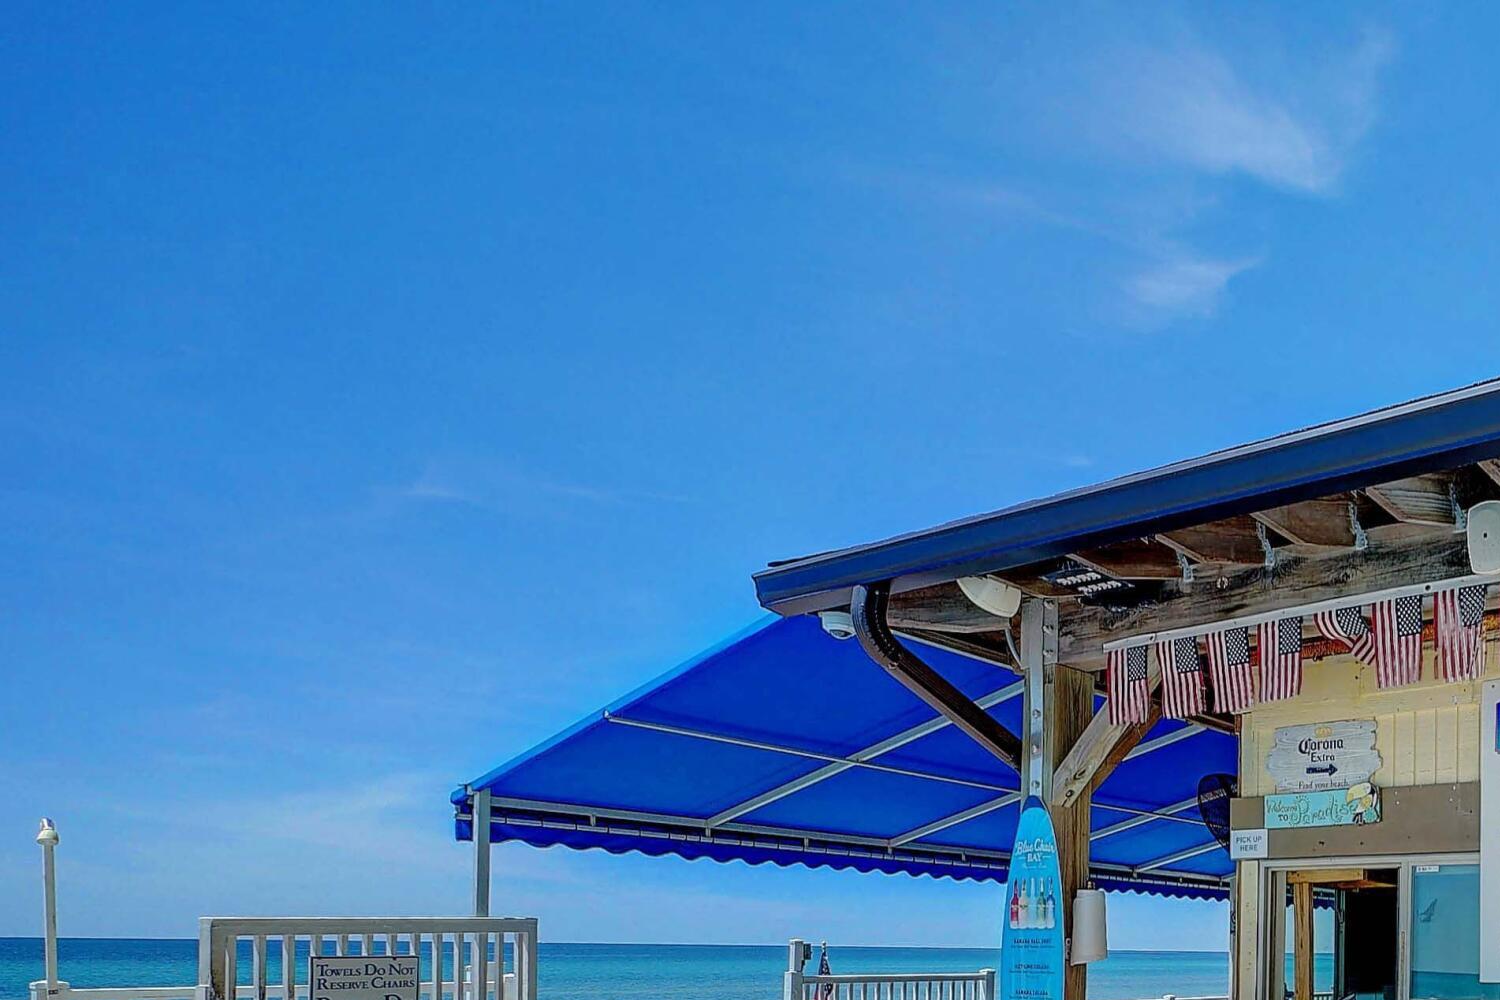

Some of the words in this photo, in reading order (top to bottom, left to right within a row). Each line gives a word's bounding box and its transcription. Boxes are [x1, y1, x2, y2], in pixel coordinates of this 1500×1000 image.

[1298, 738, 1343, 756] Corona
[1311, 753, 1335, 762] Extra
[1236, 836, 1250, 844] PICK
[1015, 841, 1033, 856] Blue
[1028, 854, 1043, 862] BAY
